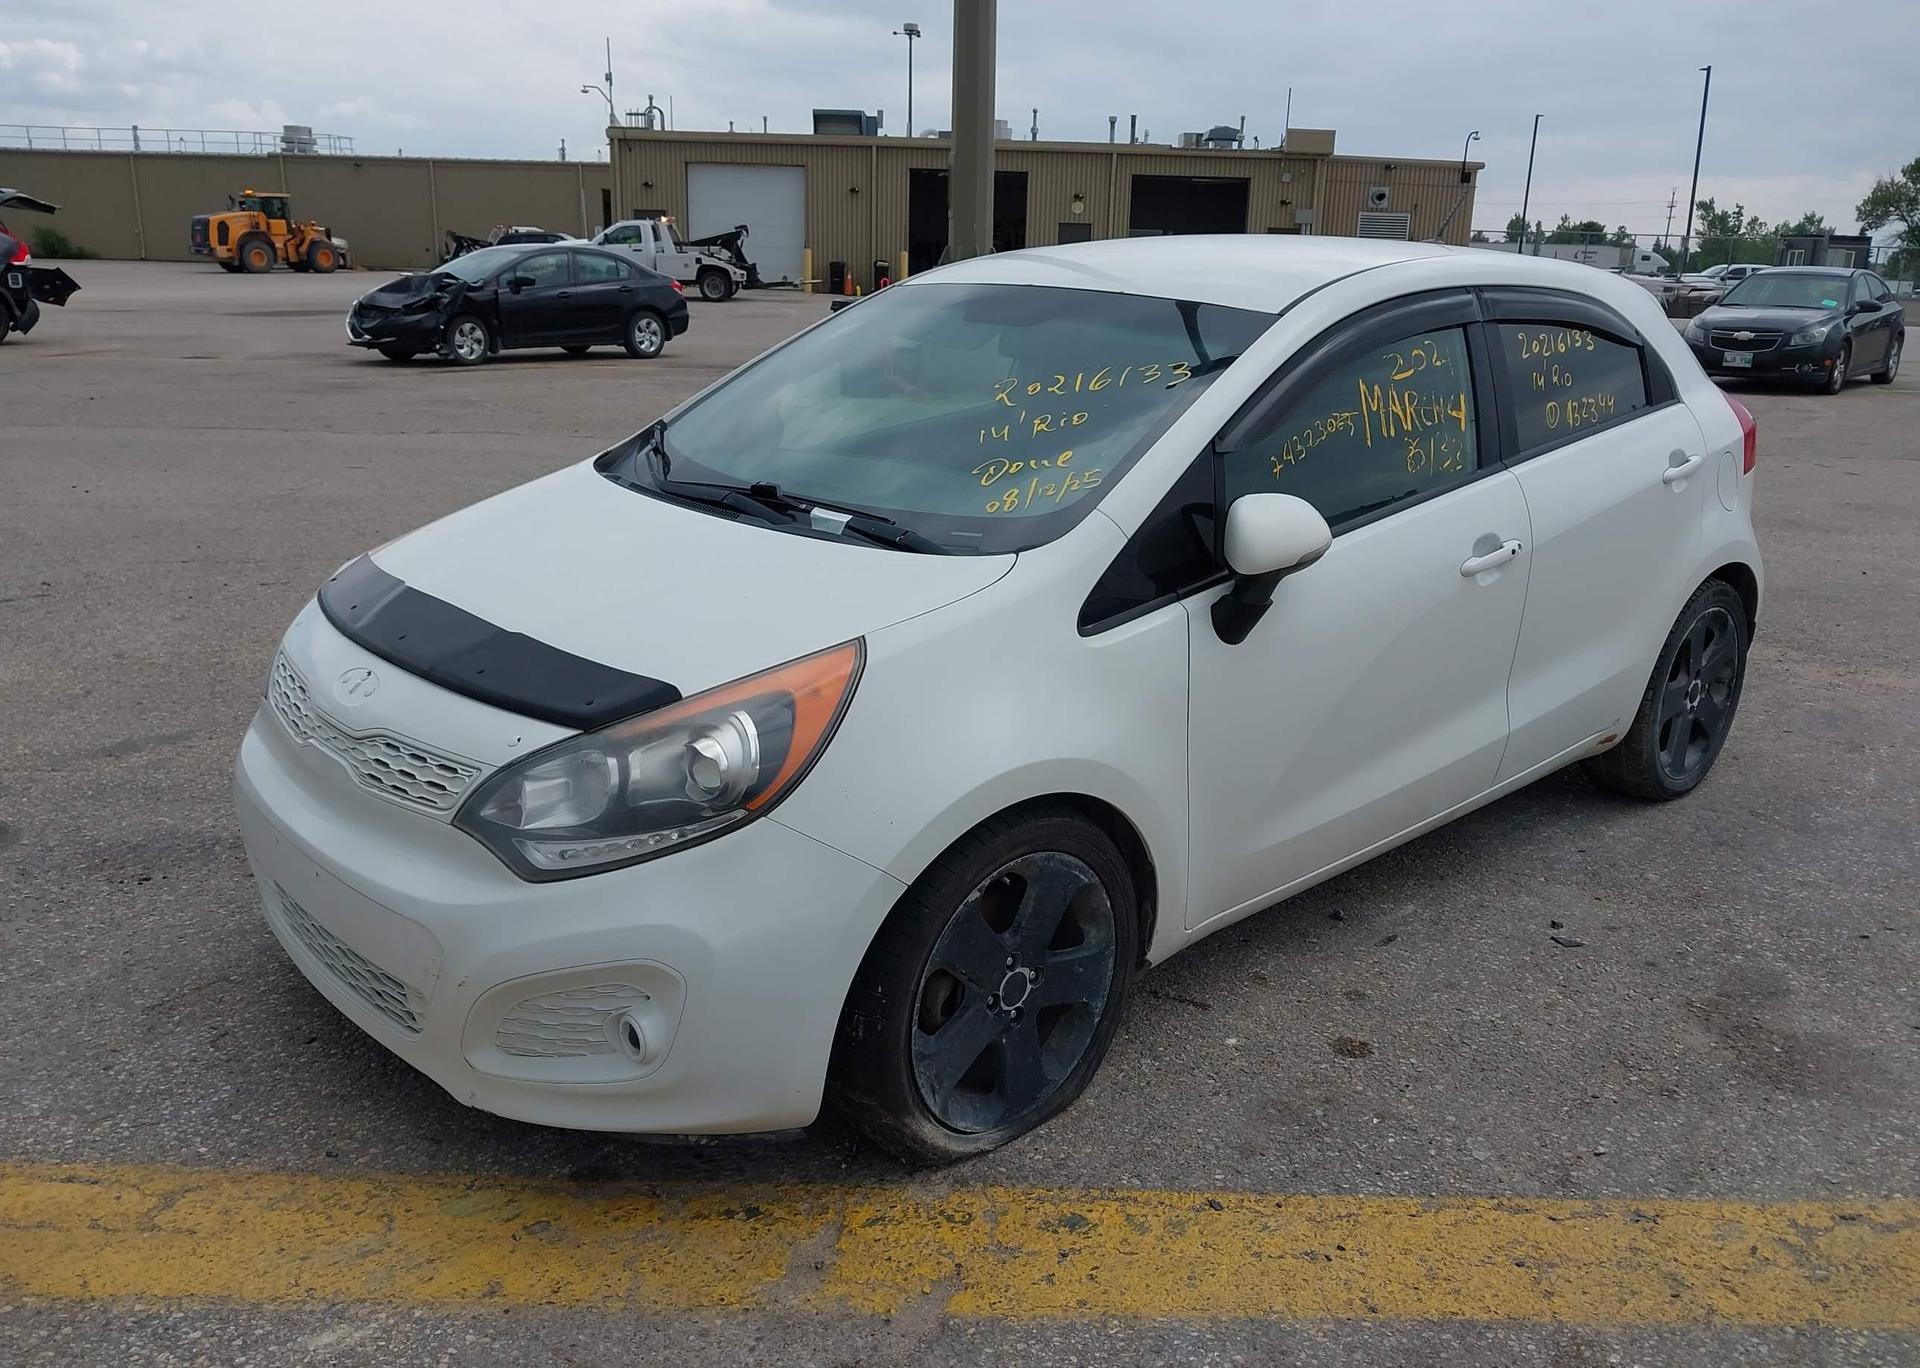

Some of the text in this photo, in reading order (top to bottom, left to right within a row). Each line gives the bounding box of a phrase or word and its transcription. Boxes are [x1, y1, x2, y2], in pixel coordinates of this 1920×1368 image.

[1518, 329, 1595, 359] 20216133
[993, 361, 1192, 407] 20216133
[1552, 364, 1573, 387] Rio
[1032, 412, 1089, 440] Rio
[972, 449, 1074, 487] Done
[985, 468, 1103, 514] 08/12/25
